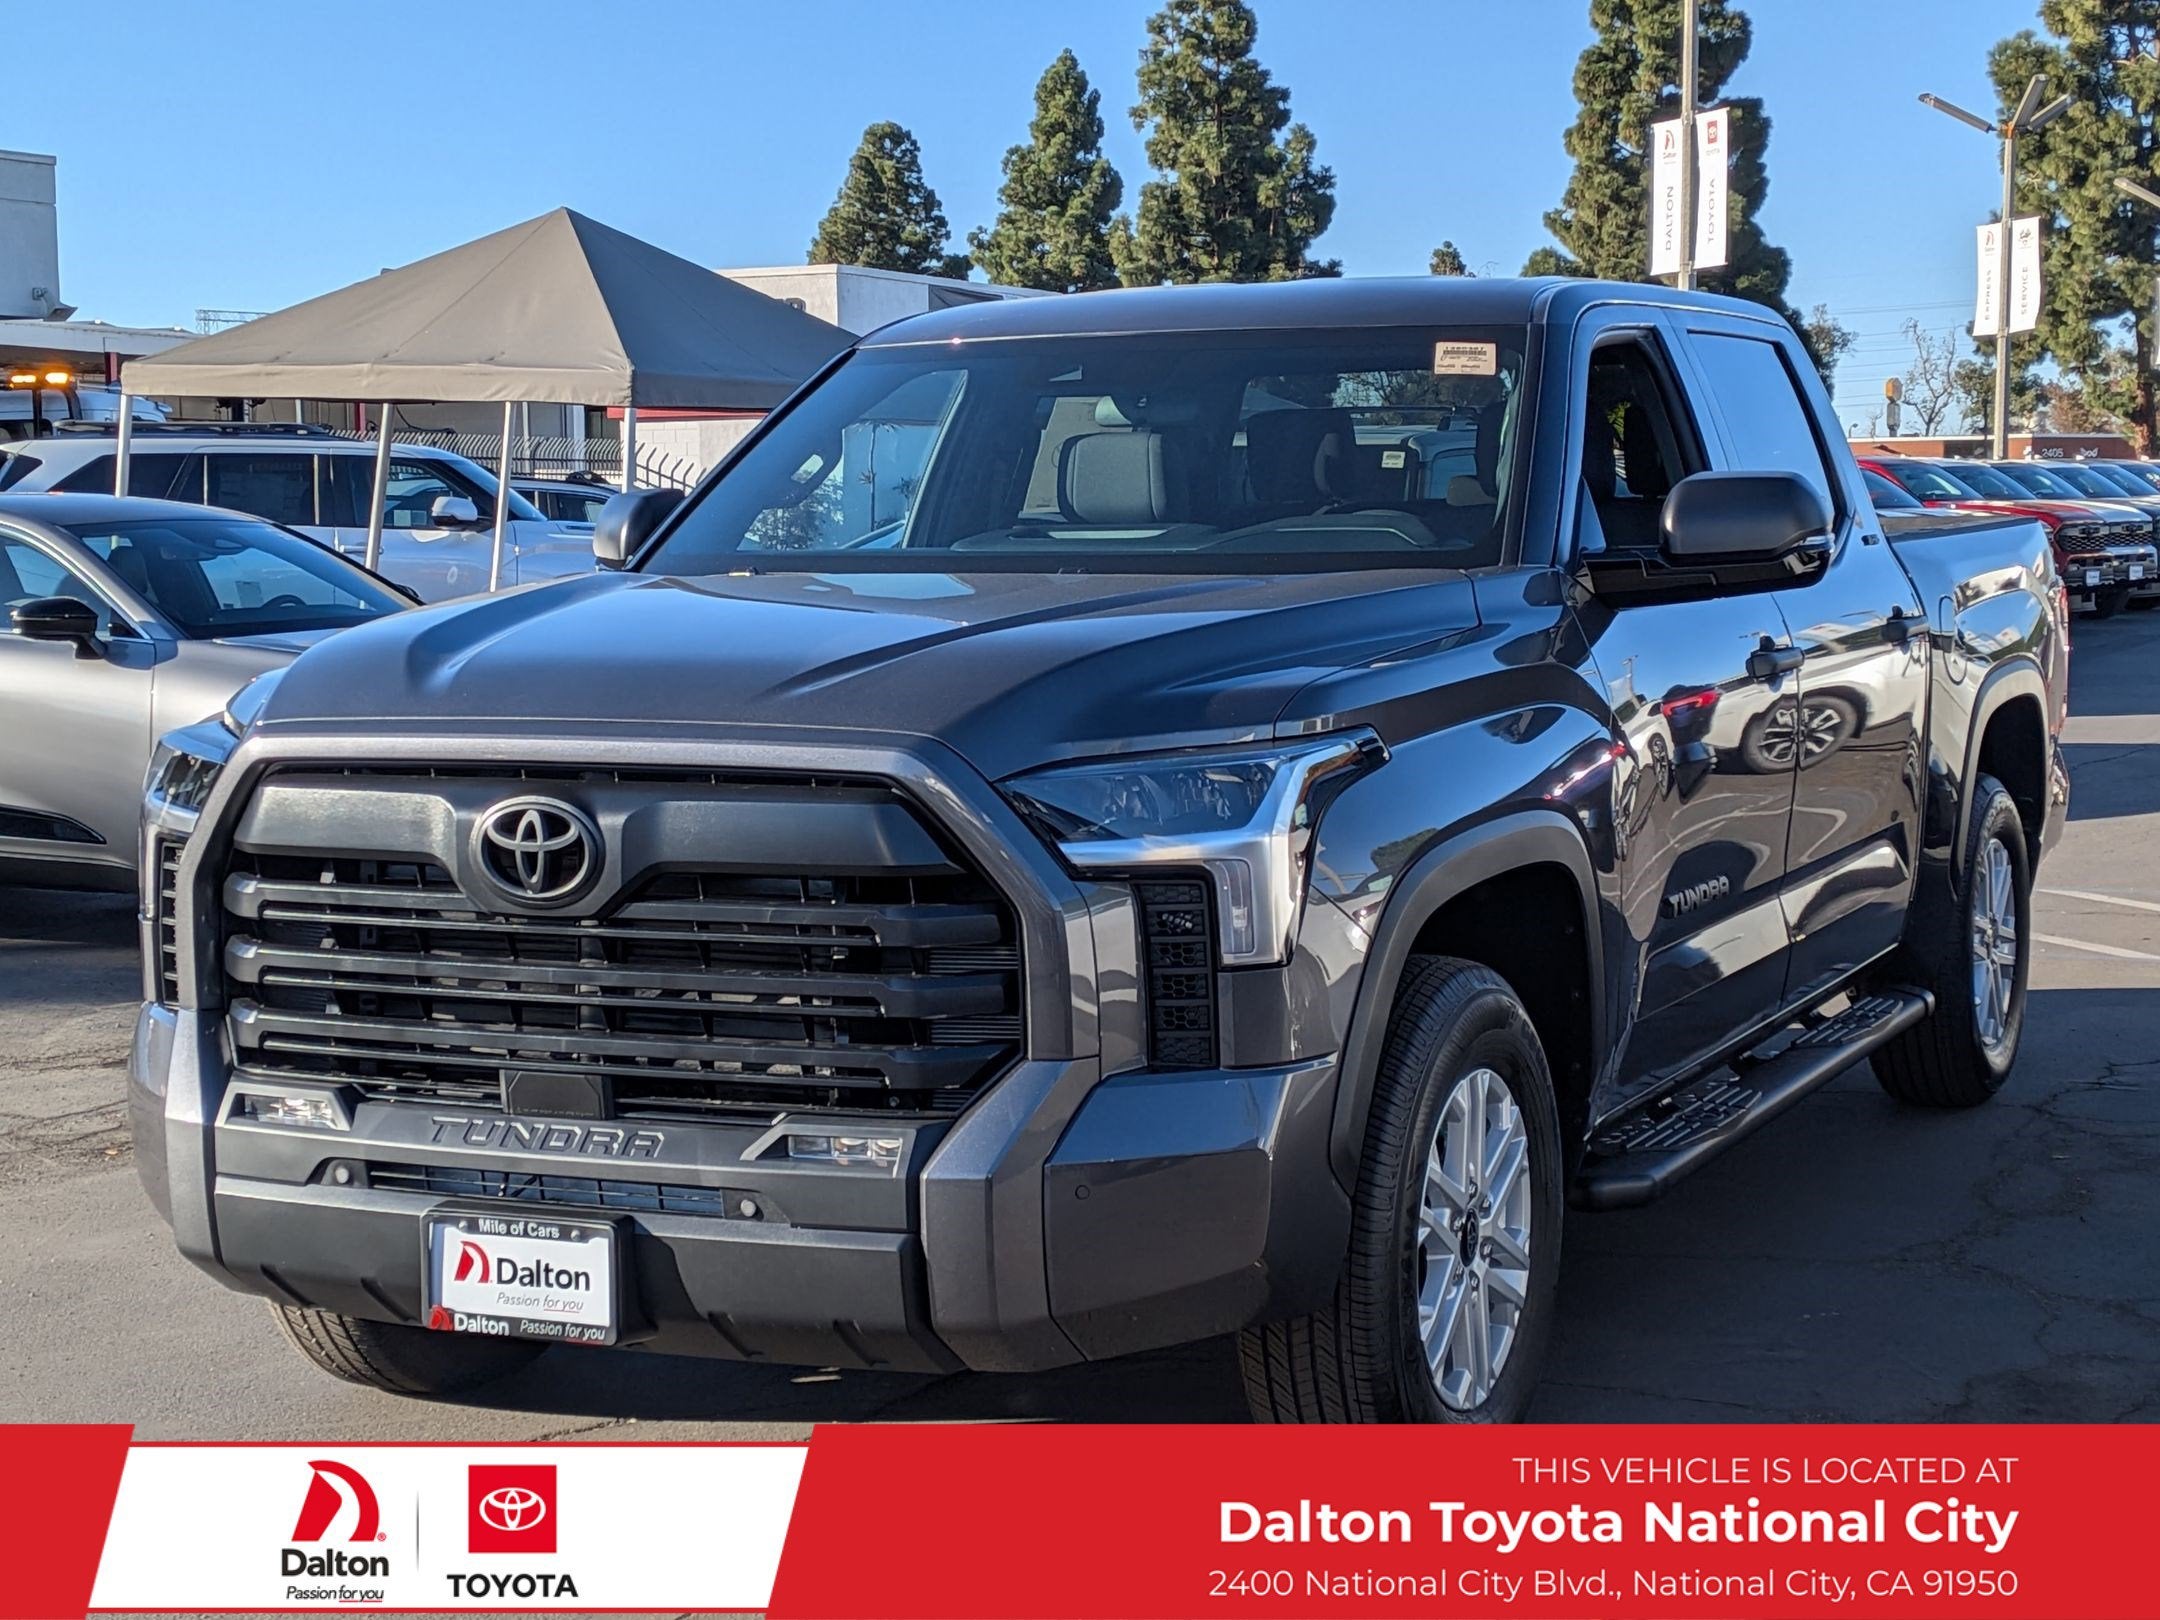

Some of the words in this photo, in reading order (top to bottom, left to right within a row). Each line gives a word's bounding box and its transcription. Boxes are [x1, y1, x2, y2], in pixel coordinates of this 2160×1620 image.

[1665, 186, 1674, 251] DALTON
[1707, 178, 1716, 245] TOYOTA
[2020, 266, 2028, 316] SERVICE
[2042, 447, 2064, 458] 2405
[1668, 875, 1729, 918] TUNDRA
[432, 1116, 665, 1158] TUNDRA
[478, 1218, 507, 1235] Mile
[510, 1221, 525, 1236] of
[527, 1222, 560, 1239] Cars
[496, 1257, 590, 1291] Dalton
[496, 1292, 541, 1307] Passion
[542, 1295, 560, 1310] for
[562, 1299, 584, 1312] you
[454, 1313, 510, 1336] Dalton
[519, 1319, 563, 1337] Passion
[564, 1322, 583, 1338] for
[582, 1326, 606, 1342] you
